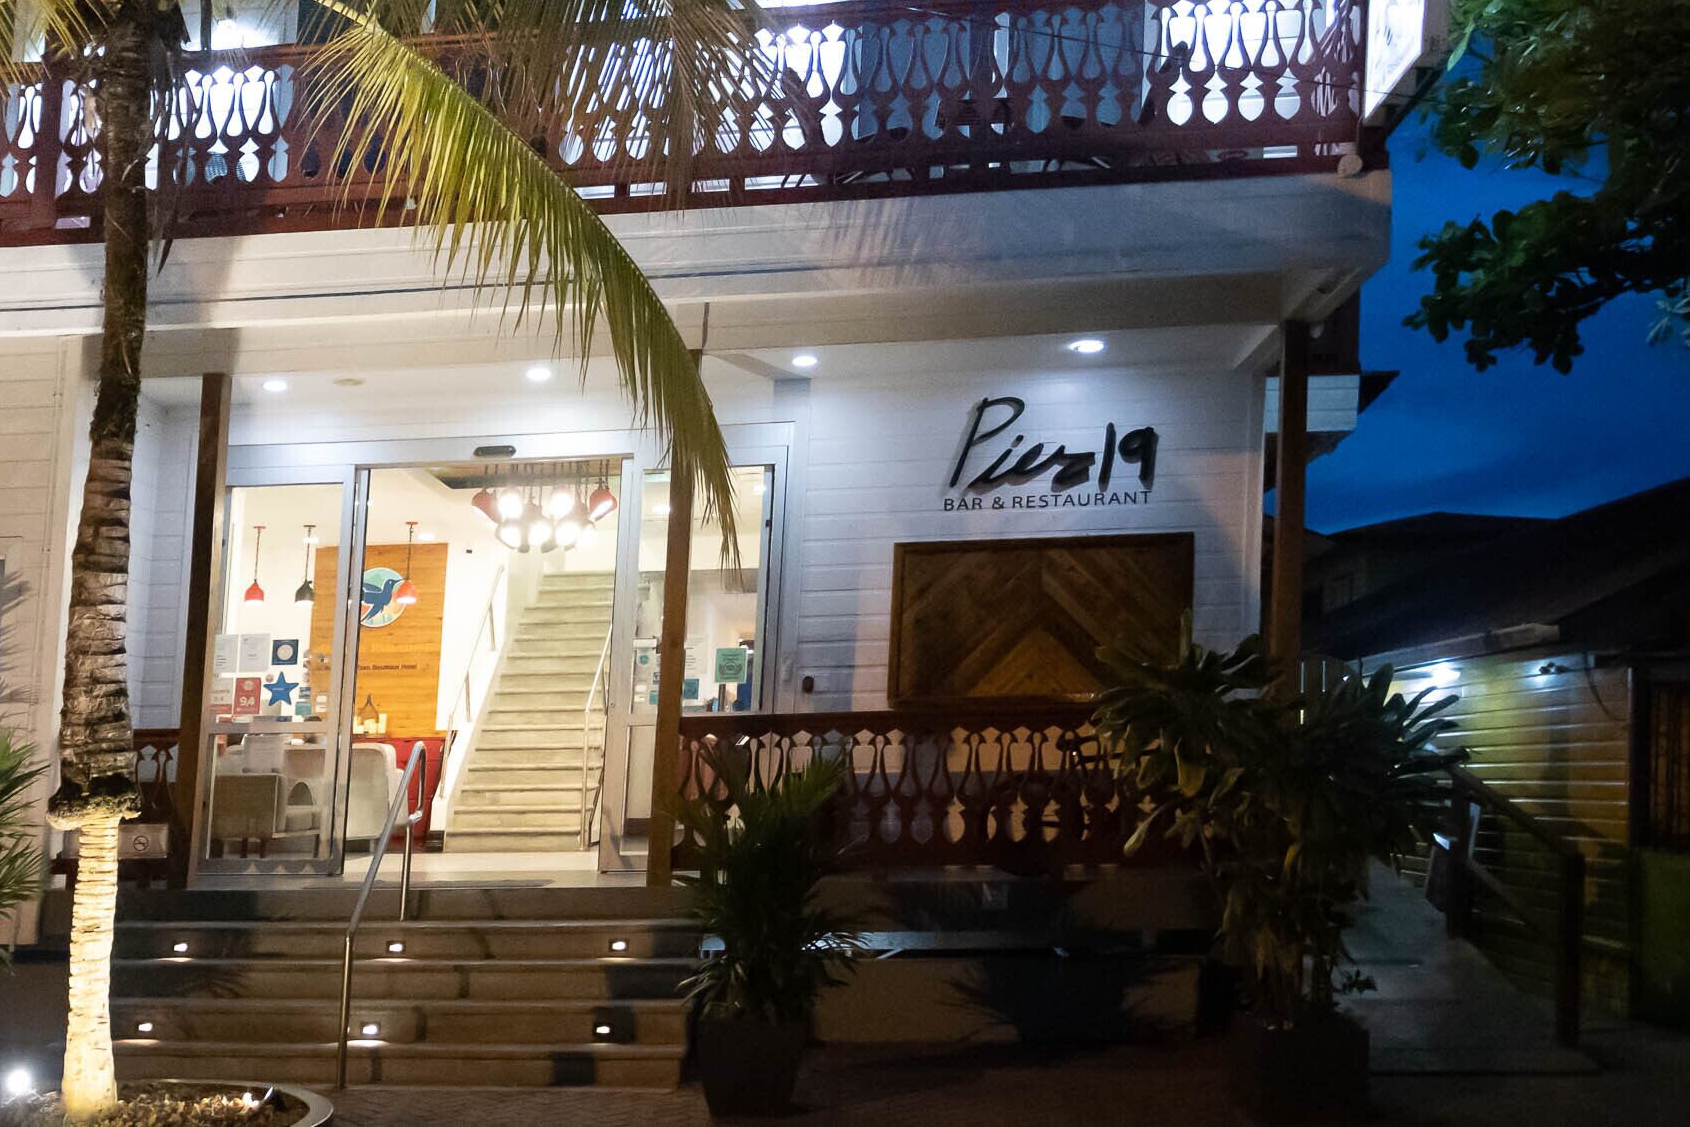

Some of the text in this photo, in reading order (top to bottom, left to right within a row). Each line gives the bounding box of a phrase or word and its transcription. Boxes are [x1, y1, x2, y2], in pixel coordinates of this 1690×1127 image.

[943, 490, 1152, 512] BAR & RESTAURANT
